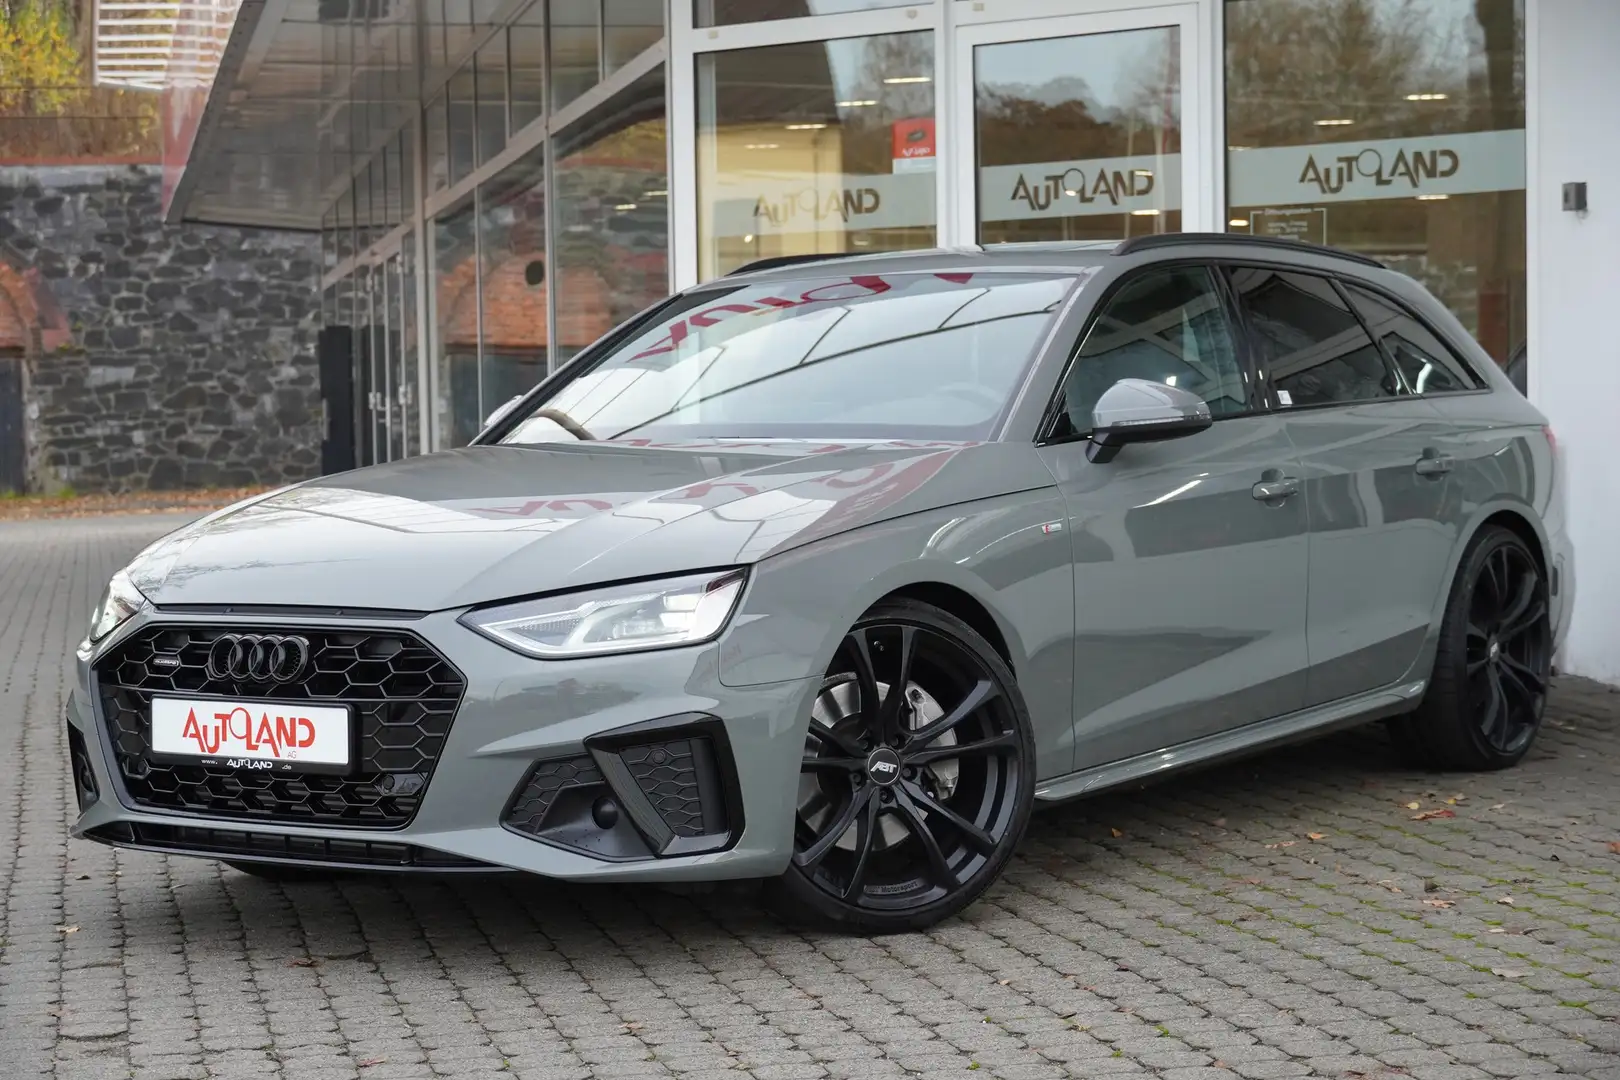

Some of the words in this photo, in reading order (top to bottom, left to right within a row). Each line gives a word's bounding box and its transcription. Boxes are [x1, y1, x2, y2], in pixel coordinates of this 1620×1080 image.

[1011, 168, 1154, 211] AUTOLAND
[1299, 148, 1459, 194] AUTOLAND
[753, 187, 880, 227] AUTOLAND
[183, 707, 315, 757] AUTOLAND
[226, 758, 273, 770] AUTOLAND
[287, 750, 297, 759] AG
[870, 761, 897, 773] ABT
